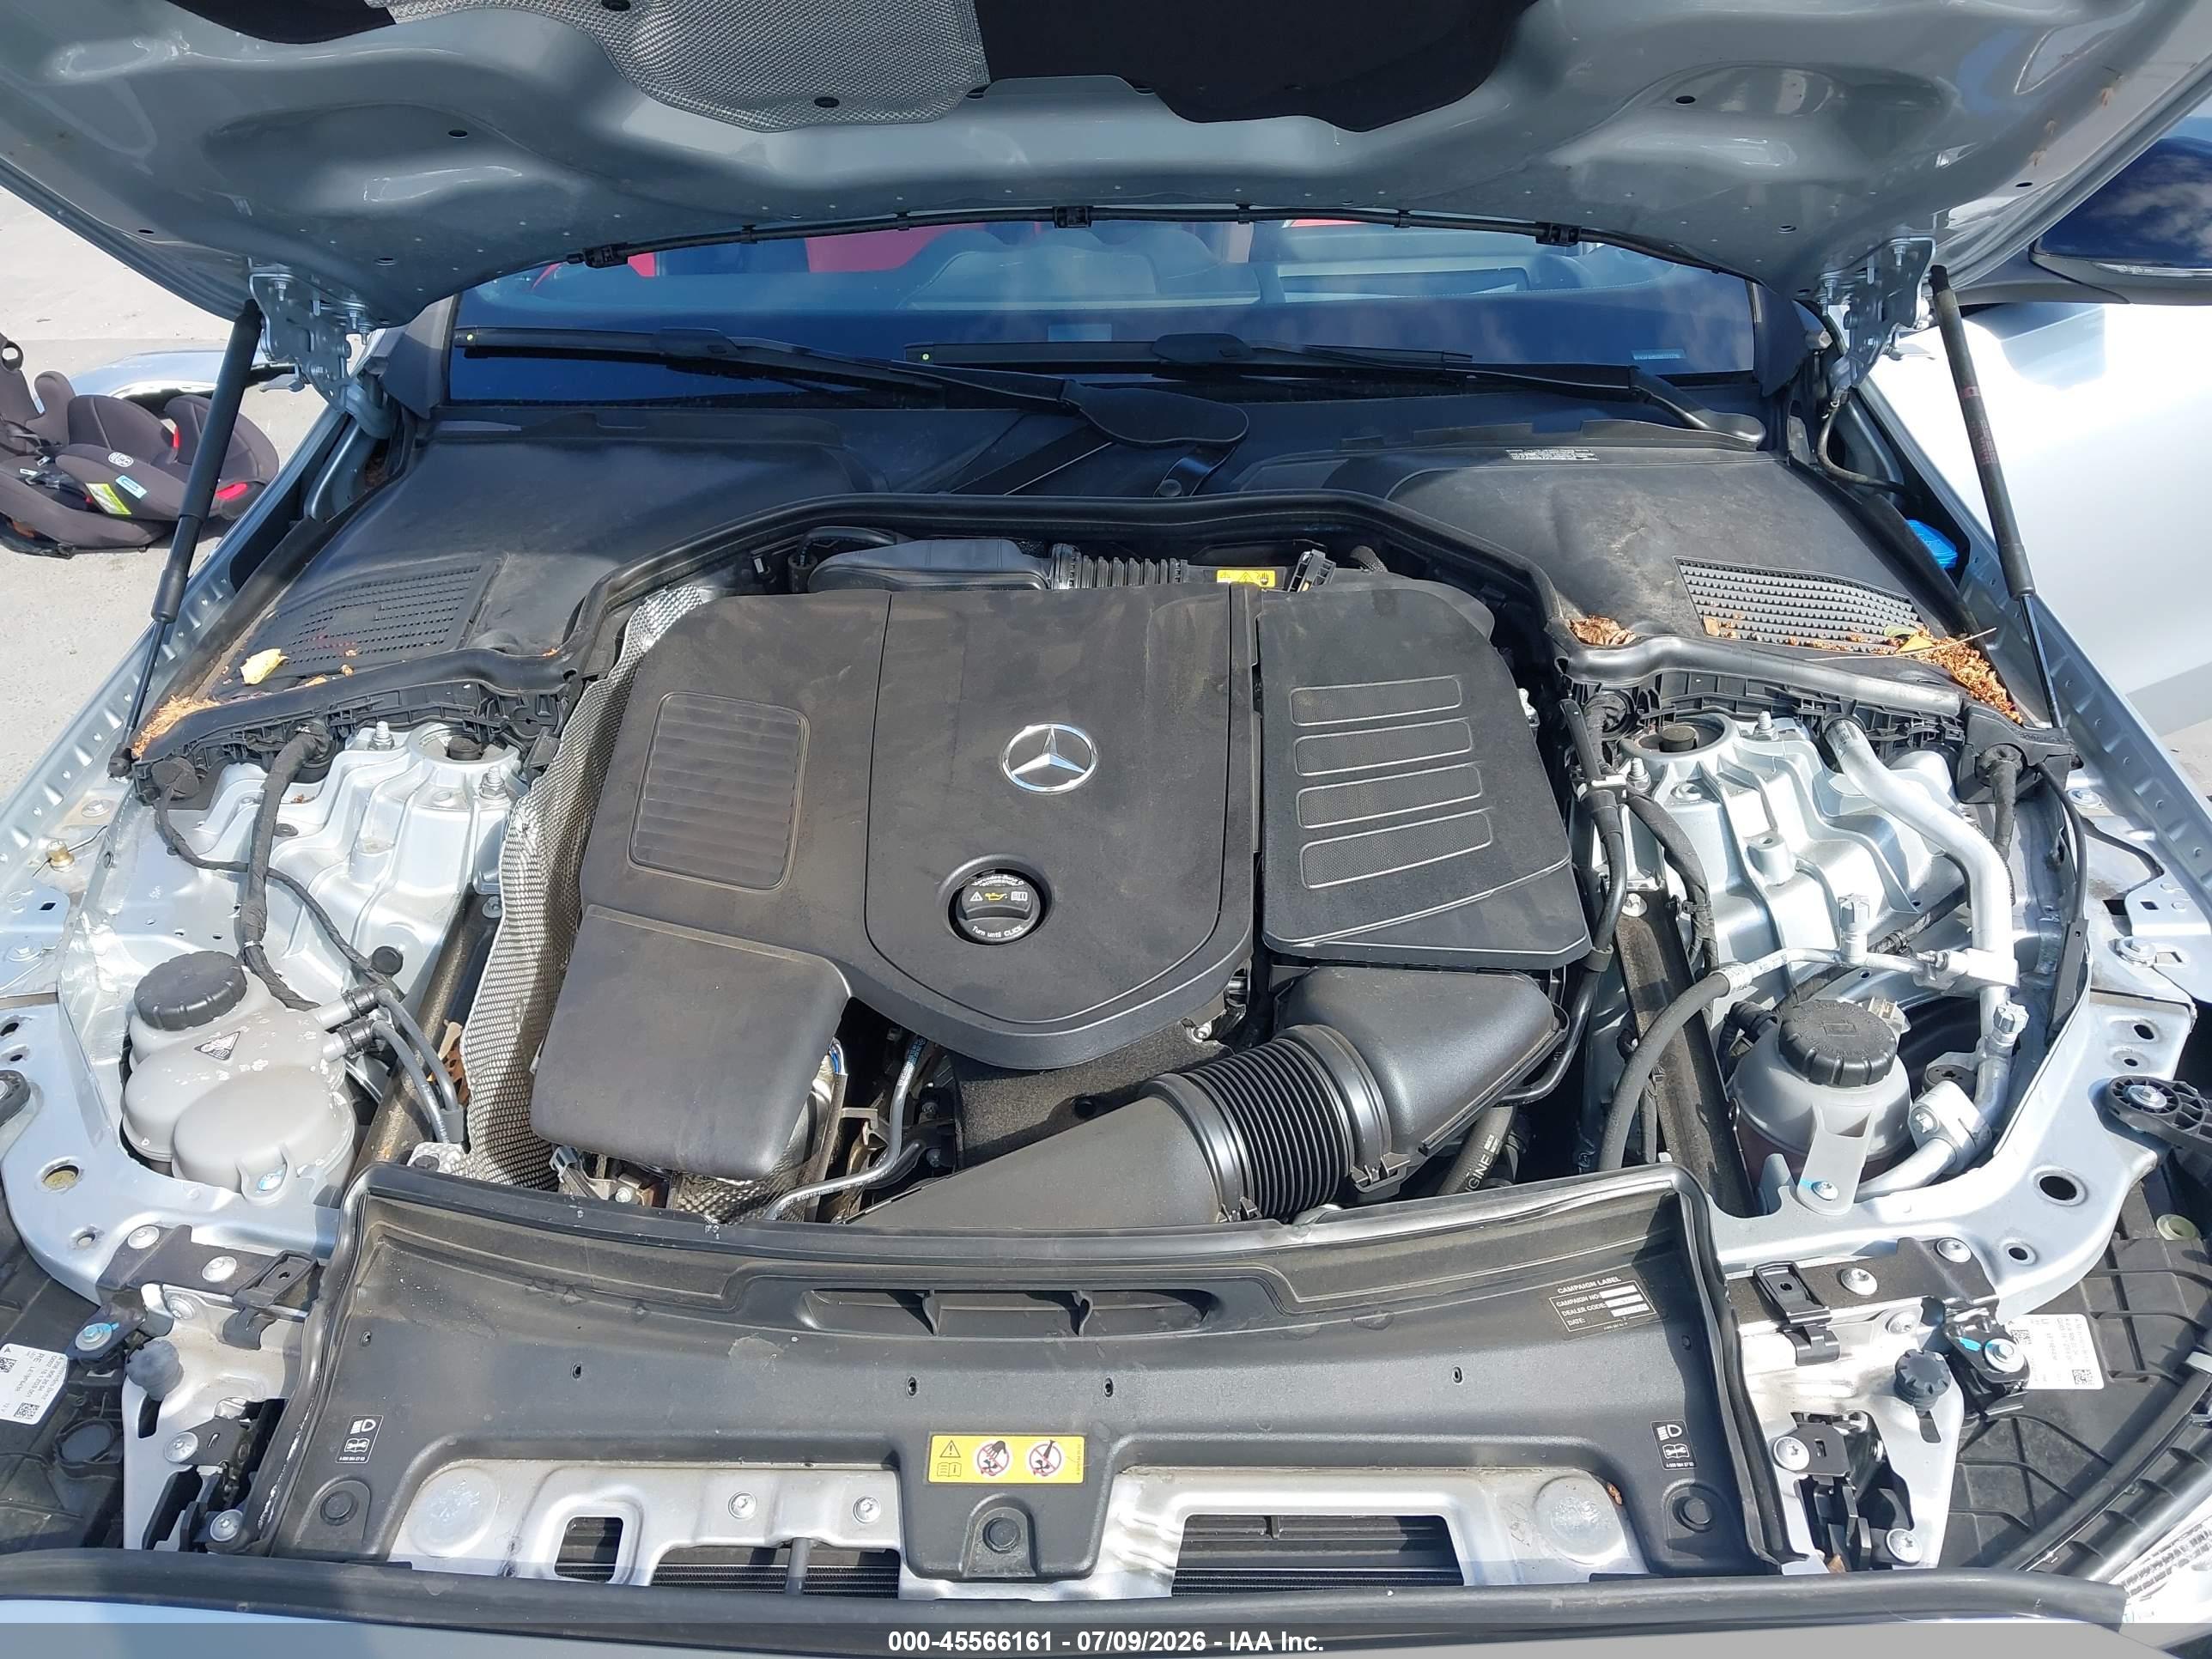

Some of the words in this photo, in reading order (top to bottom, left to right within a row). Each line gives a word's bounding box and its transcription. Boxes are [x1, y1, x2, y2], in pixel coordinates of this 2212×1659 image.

[972, 925, 986, 936] Turn
[1003, 924, 1024, 937] CLICK
[1557, 1281, 1596, 1294] CAMPAIGN
[1597, 1276, 1621, 1285] LABEL
[1556, 1296, 1589, 1307] CAMPAIGN
[1561, 1307, 1587, 1316] DEALER
[1586, 1303, 1607, 1311] CODE:
[1567, 1317, 1586, 1326] DATE:
